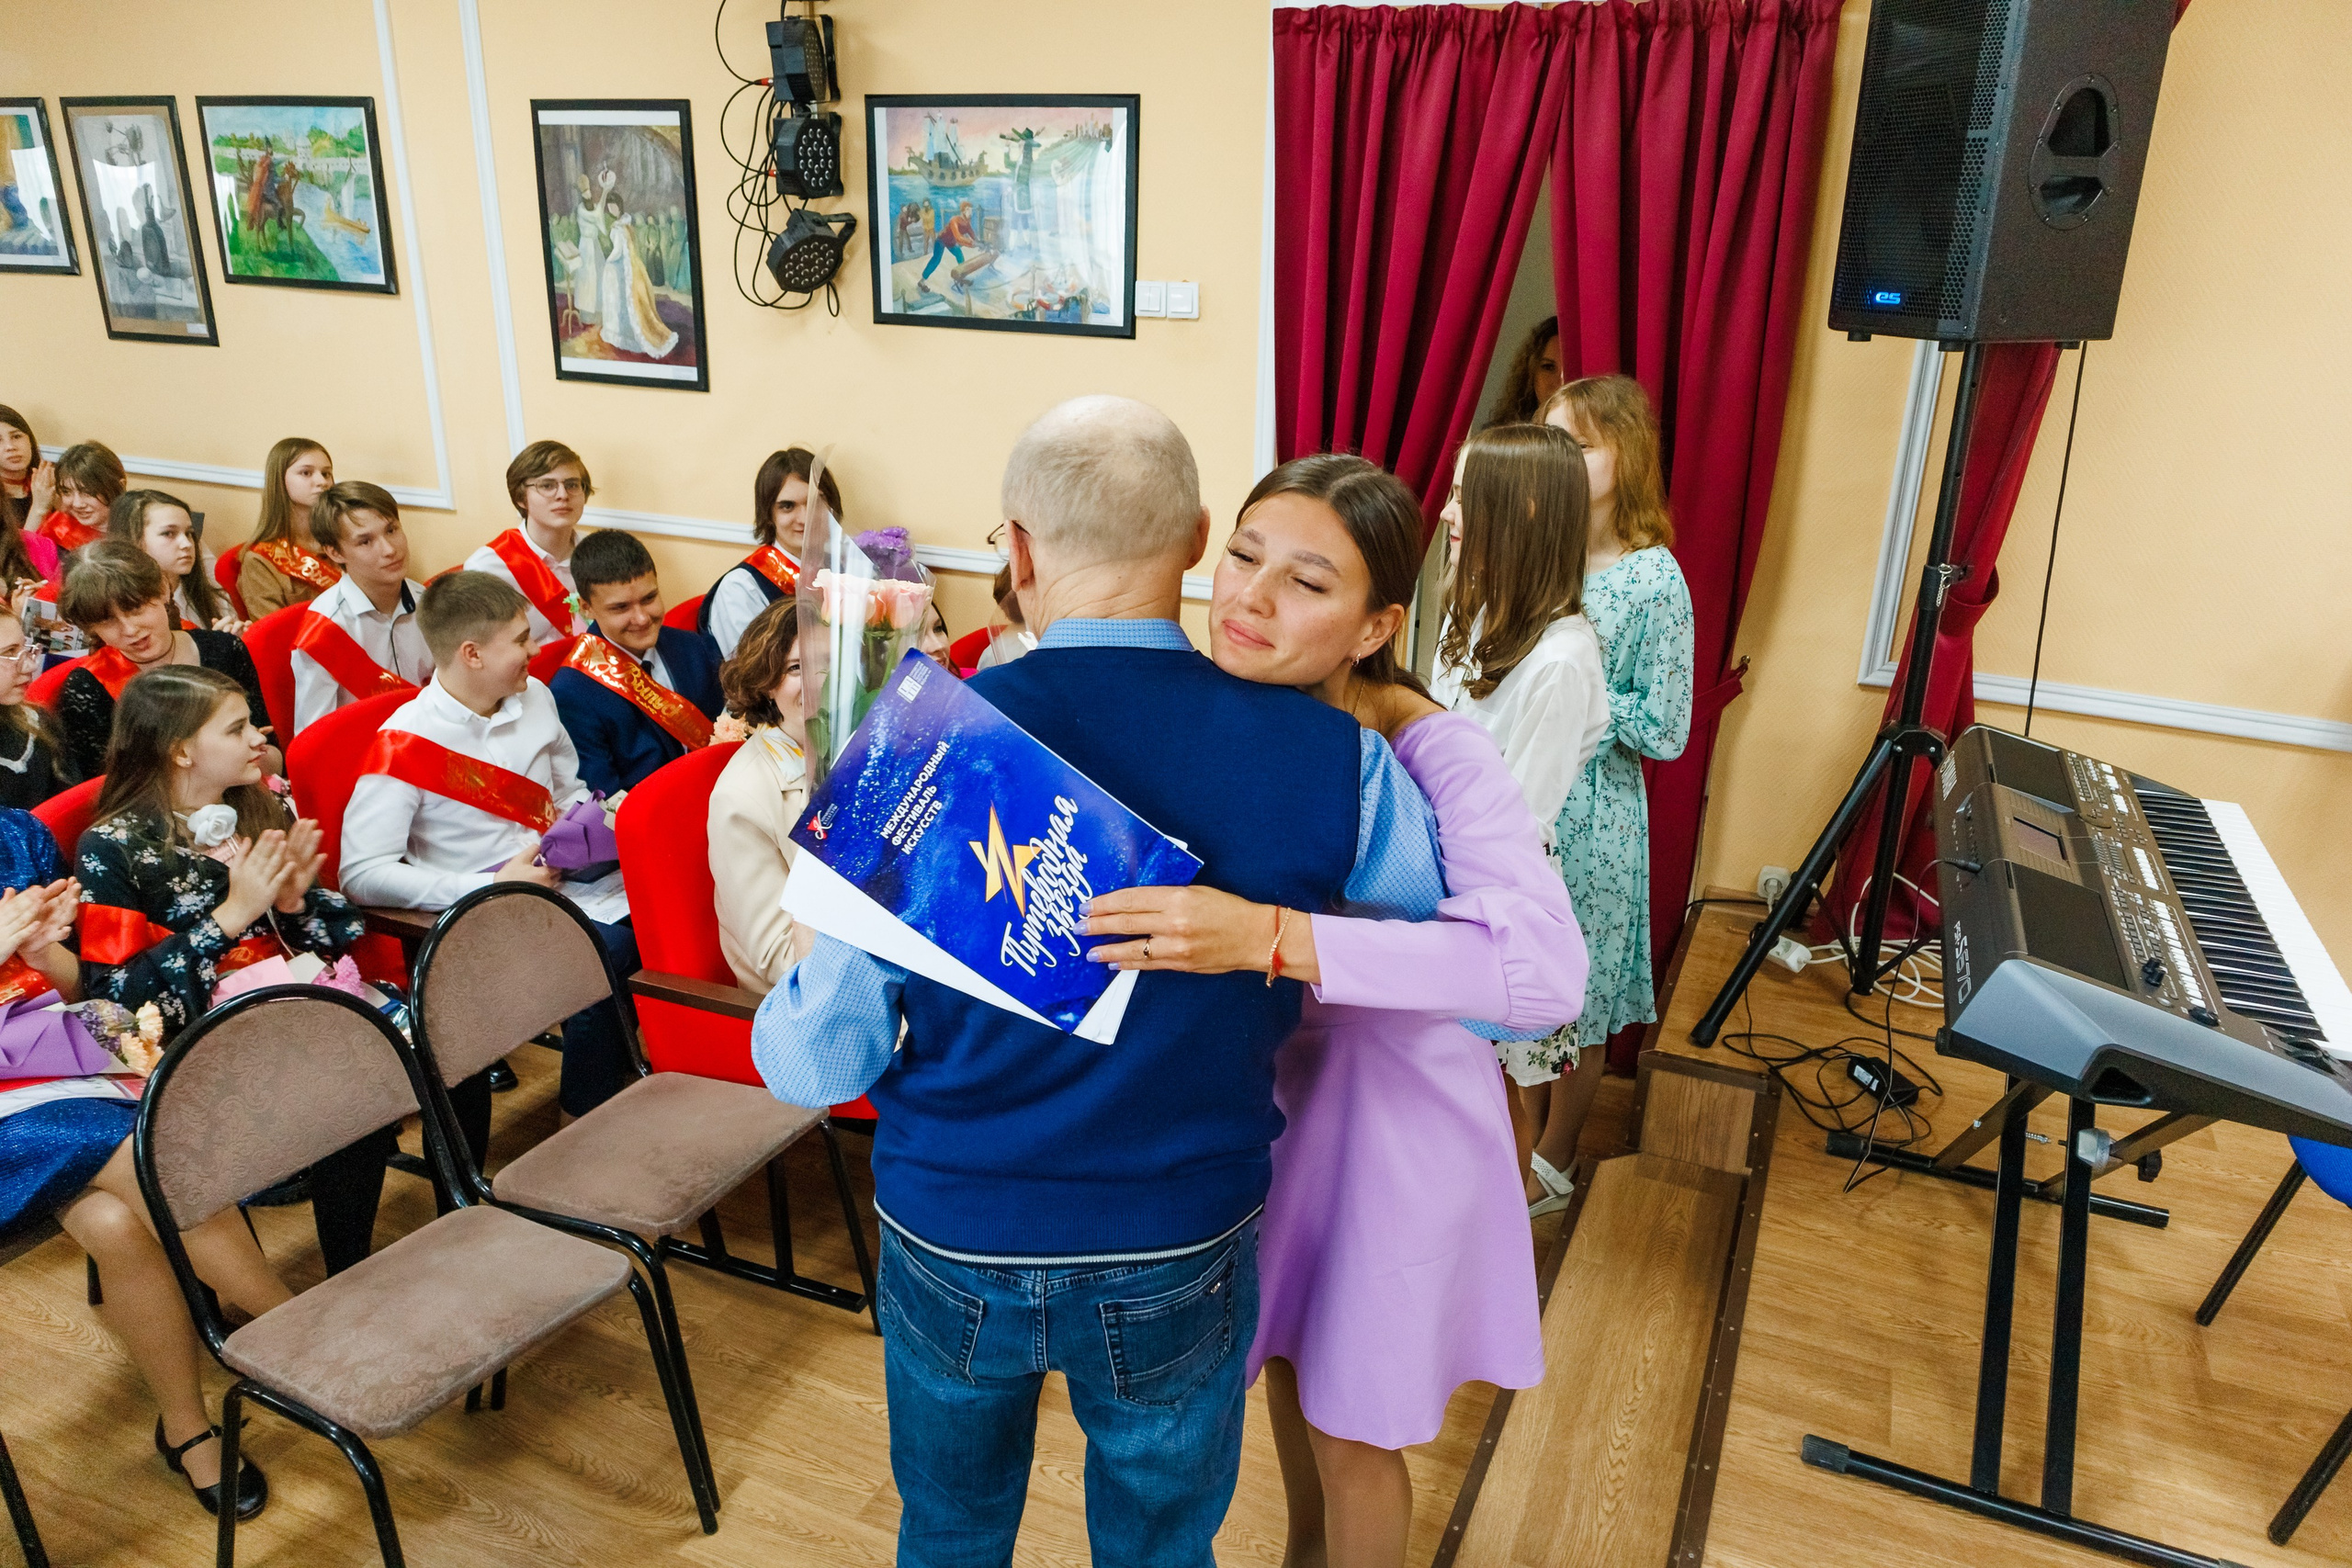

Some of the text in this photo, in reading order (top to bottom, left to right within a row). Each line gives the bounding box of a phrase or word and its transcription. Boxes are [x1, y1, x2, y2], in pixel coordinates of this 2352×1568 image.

[879, 740, 951, 840] МЕЖДУНАРОДНЫЙ
[891, 785, 938, 846] ФЕСТИВАЛЬ
[900, 799, 944, 855] ИСКУССТВ
[1000, 795, 1080, 977] Путеводная
[1046, 844, 1093, 958] звезда
